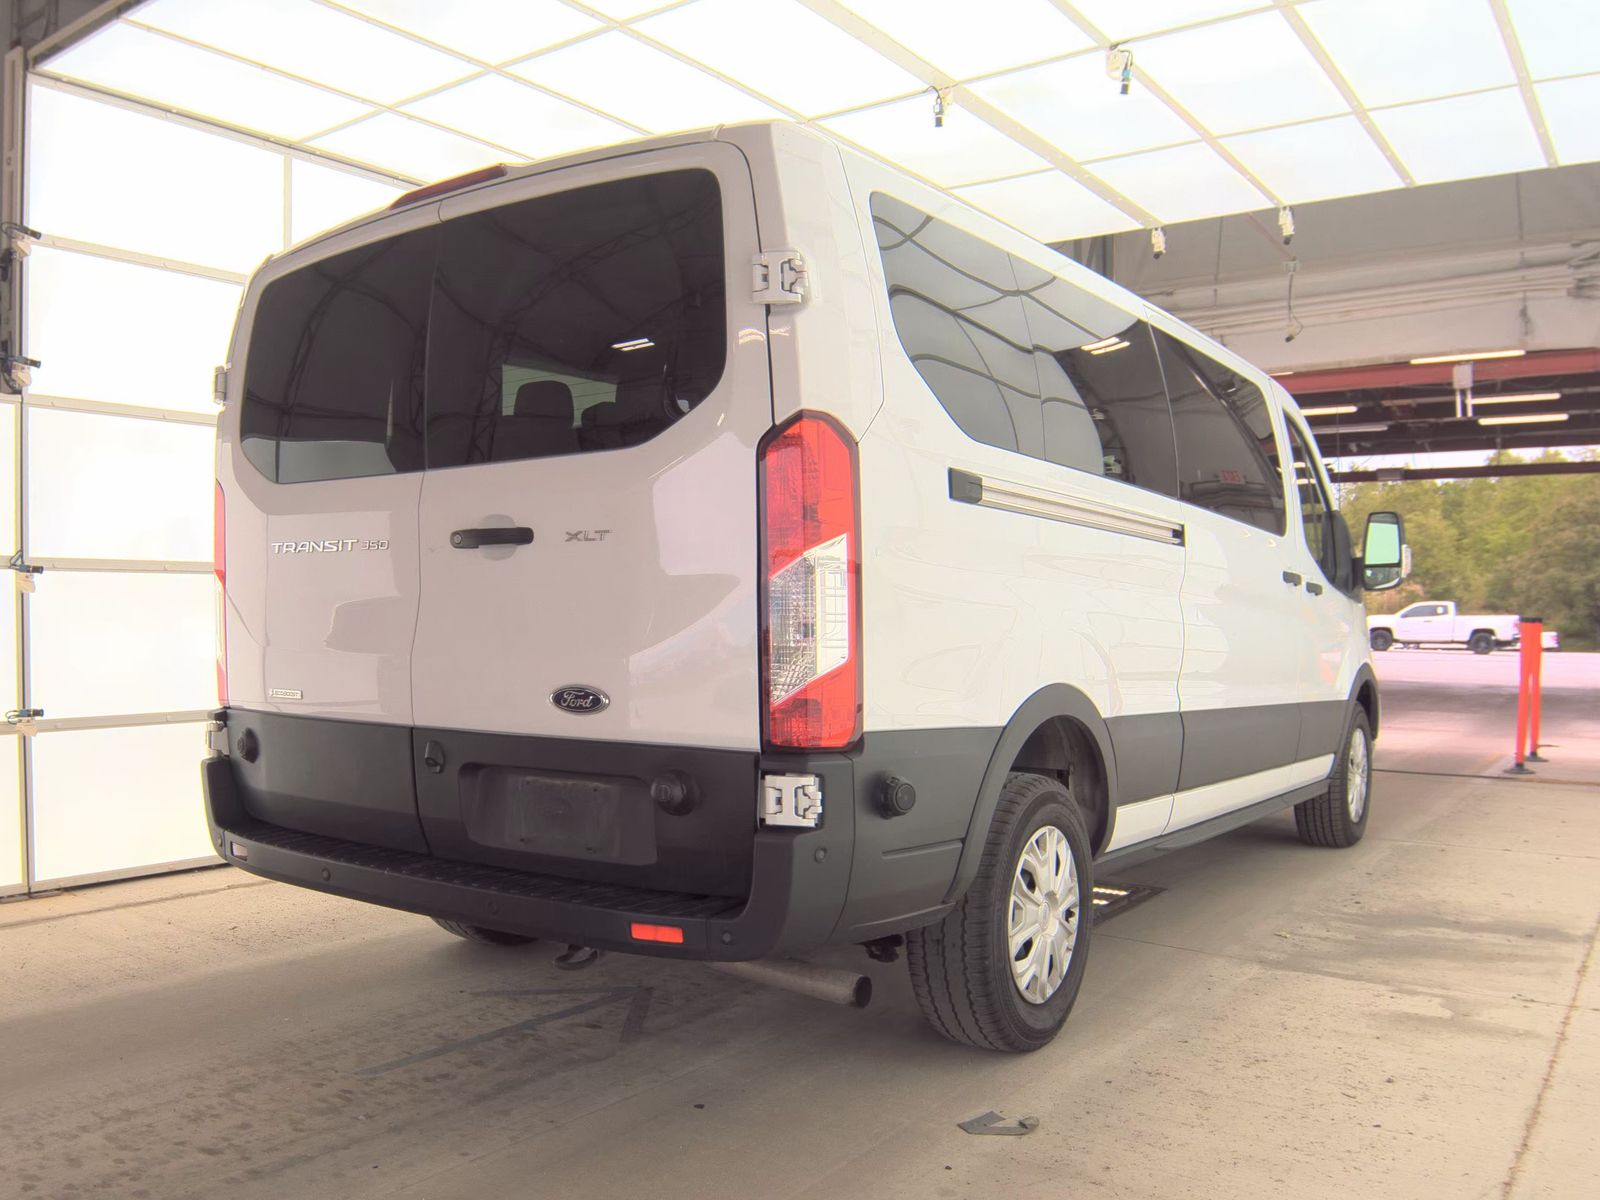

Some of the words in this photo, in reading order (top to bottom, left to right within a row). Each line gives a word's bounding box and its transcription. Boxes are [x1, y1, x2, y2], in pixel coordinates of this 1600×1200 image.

[564, 529, 612, 542] XLT
[271, 539, 359, 554] TRANSIT
[360, 540, 389, 551] 350
[560, 690, 593, 707] Ford
